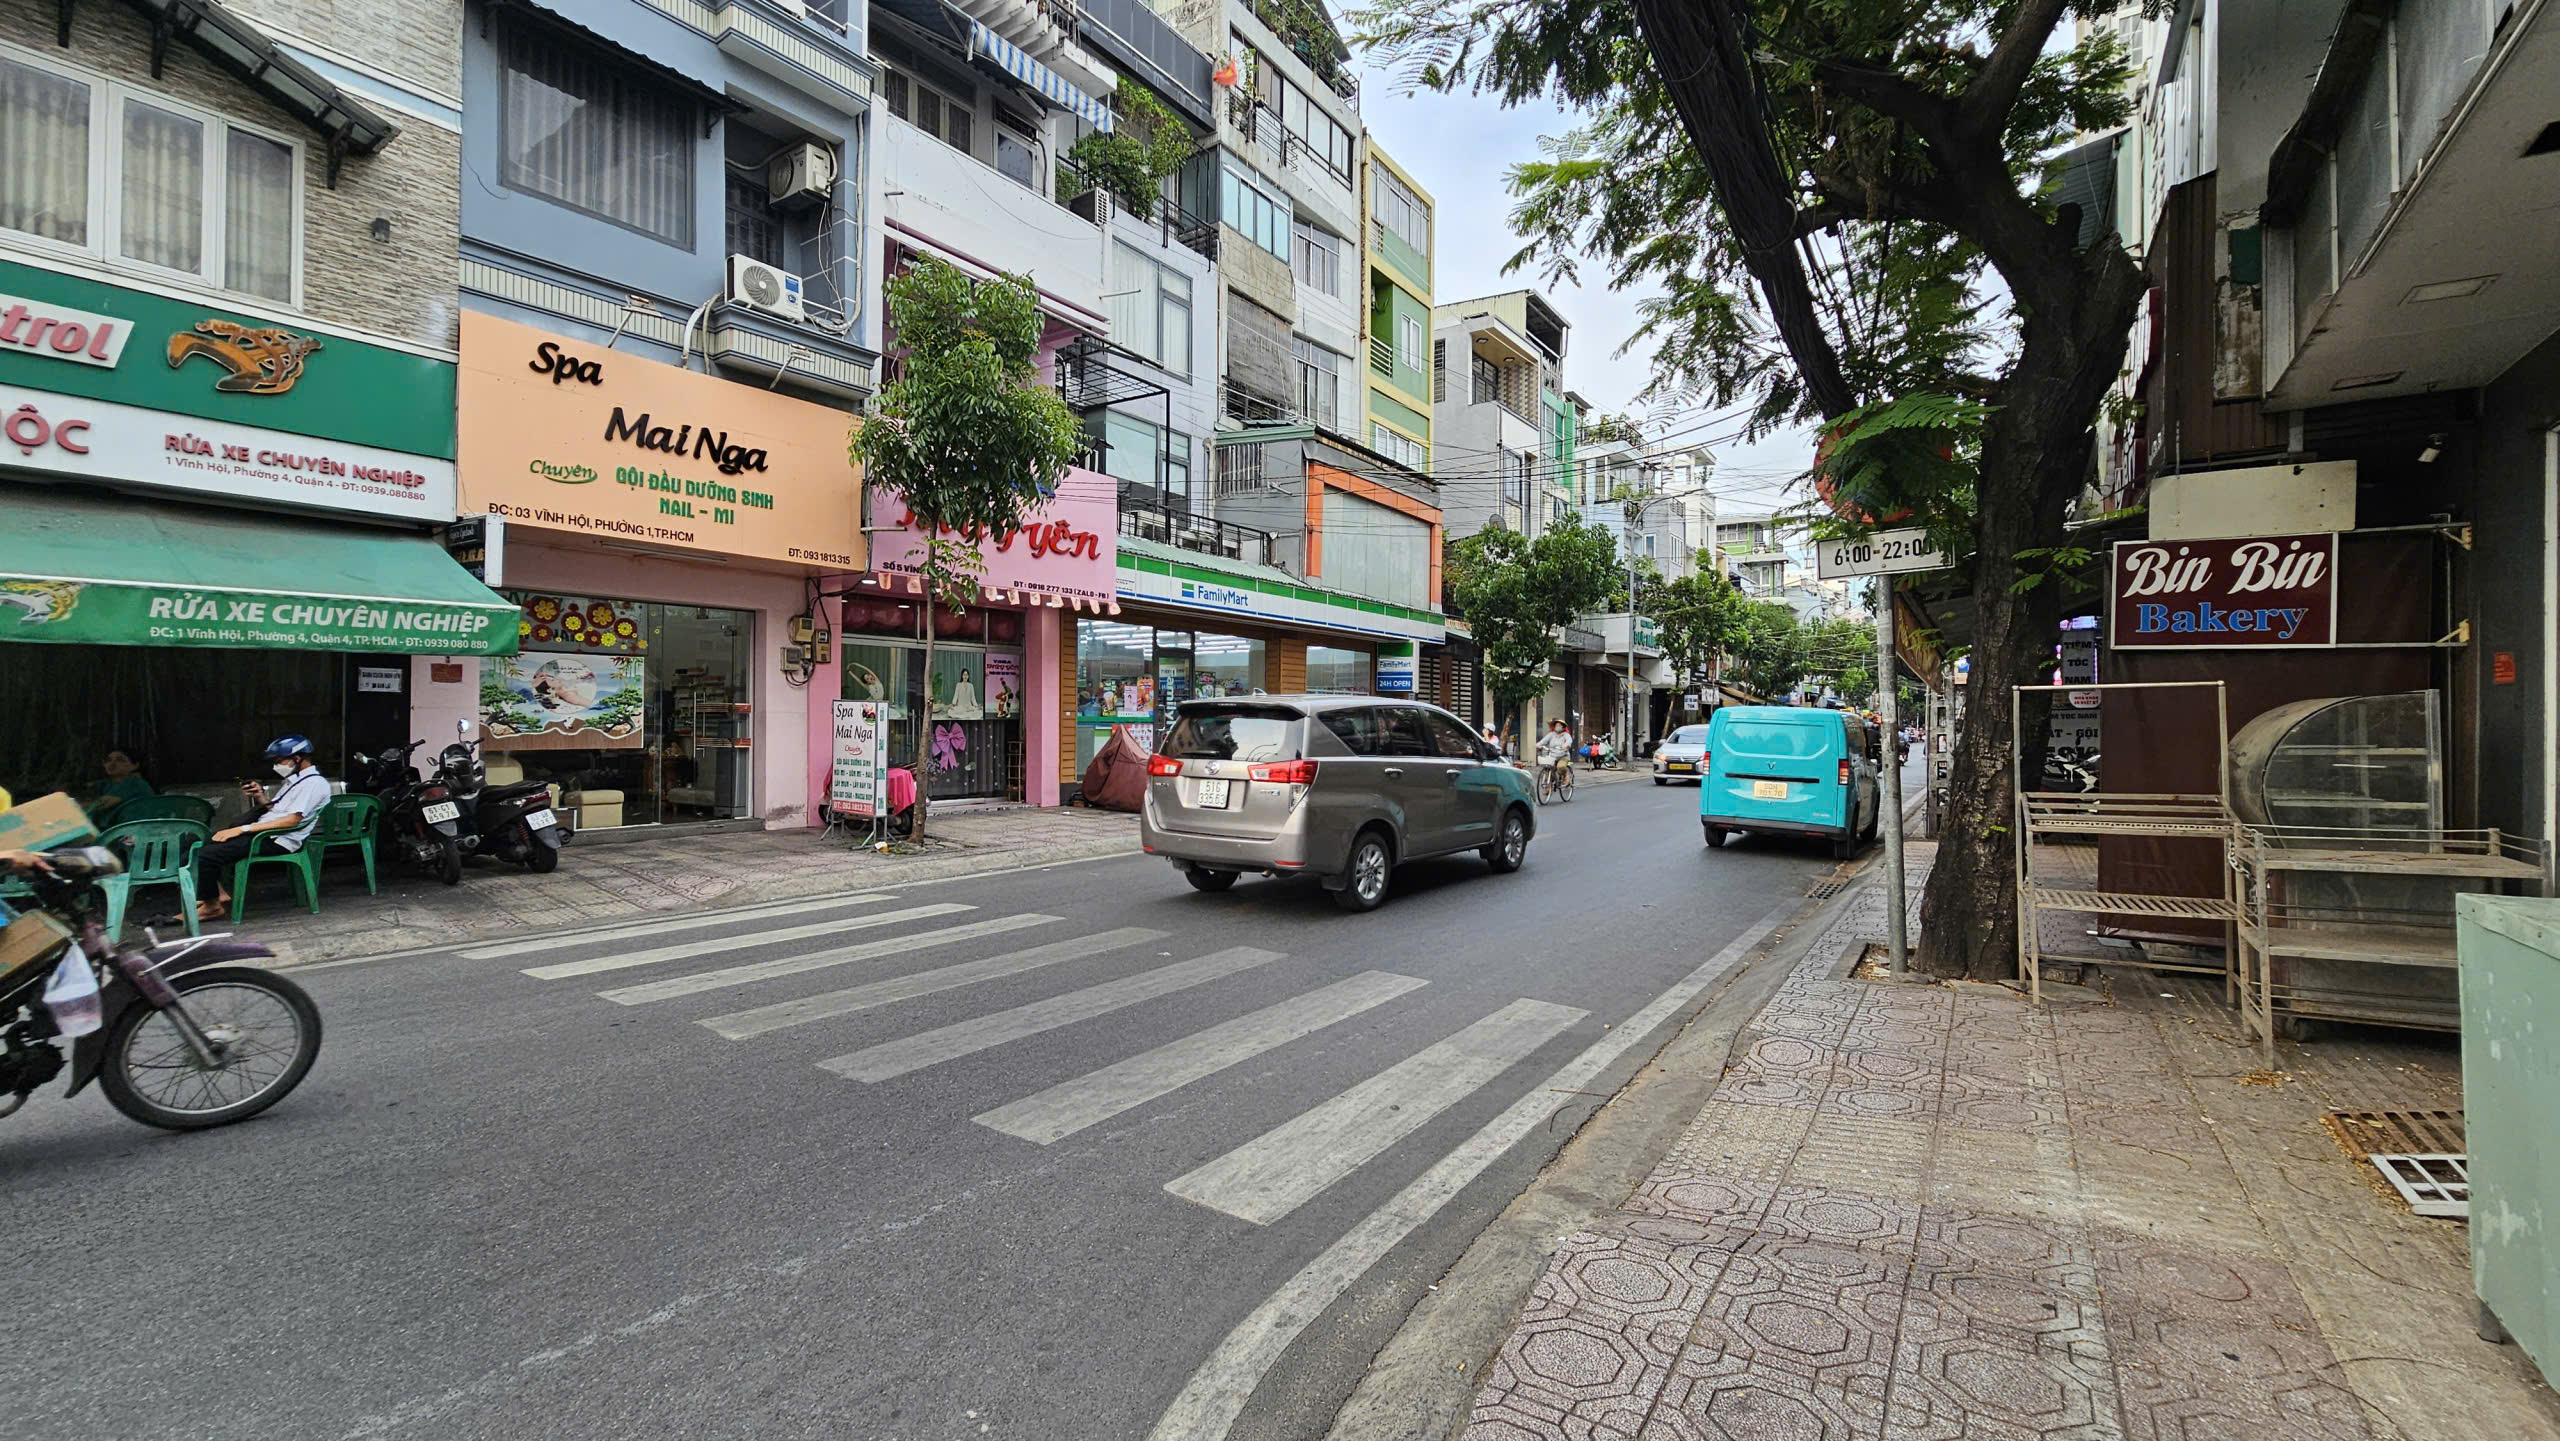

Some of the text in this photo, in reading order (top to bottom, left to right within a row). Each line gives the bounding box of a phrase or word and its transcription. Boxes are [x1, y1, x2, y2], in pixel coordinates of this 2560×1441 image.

[0, 304, 114, 361] trol
[528, 342, 604, 386] Spa
[0, 404, 91, 456] ỘC
[604, 407, 769, 475] Mai Nga
[164, 433, 426, 490] RỬA XE CHUYÊN NGHIỆP
[165, 456, 171, 465] 1
[175, 457, 204, 470] Vĩnh
[207, 461, 231, 475] Hội,
[234, 465, 279, 482] Phường
[281, 473, 292, 483] 4,
[294, 475, 324, 488] Quận
[529, 459, 598, 484] Chuyên
[616, 466, 774, 510] GỘI ĐẦU DƯỠNG SINH
[489, 502, 513, 516] ĐC:
[515, 506, 531, 519] 03
[534, 508, 565, 524] VĨNH
[568, 513, 593, 530] HỘI,
[594, 518, 645, 536] PHƯỜNG
[659, 497, 695, 519] NAIL
[713, 507, 735, 525] MI
[788, 548, 803, 559] ĐT:
[1020, 519, 1101, 561] Yên
[2122, 540, 2327, 598] Bin Bin
[1198, 585, 1248, 606] FamilyMart
[149, 592, 219, 621] RỬA
[223, 601, 267, 623] XE
[271, 604, 389, 630] CHUYÊN
[393, 611, 489, 638] NGHIỆP
[2136, 602, 2309, 639] Bakery
[150, 626, 174, 638] ĐC:
[177, 628, 183, 638] 1
[187, 627, 217, 640] Vĩnh
[219, 629, 245, 643] Hội,
[247, 630, 295, 644] Phường
[297, 633, 309, 643] 4,
[310, 633, 341, 646] Quận
[342, 635, 352, 645] 4,
[354, 635, 371, 646] TP.
[372, 636, 398, 646] HCM
[405, 637, 423, 647] ĐT:
[424, 638, 449, 648] 0939
[450, 639, 469, 649] 080
[470, 640, 489, 649] 880
[1393, 680, 1411, 688] OPEN
[836, 703, 854, 721] Spa
[835, 725, 873, 743] Mai Nga
